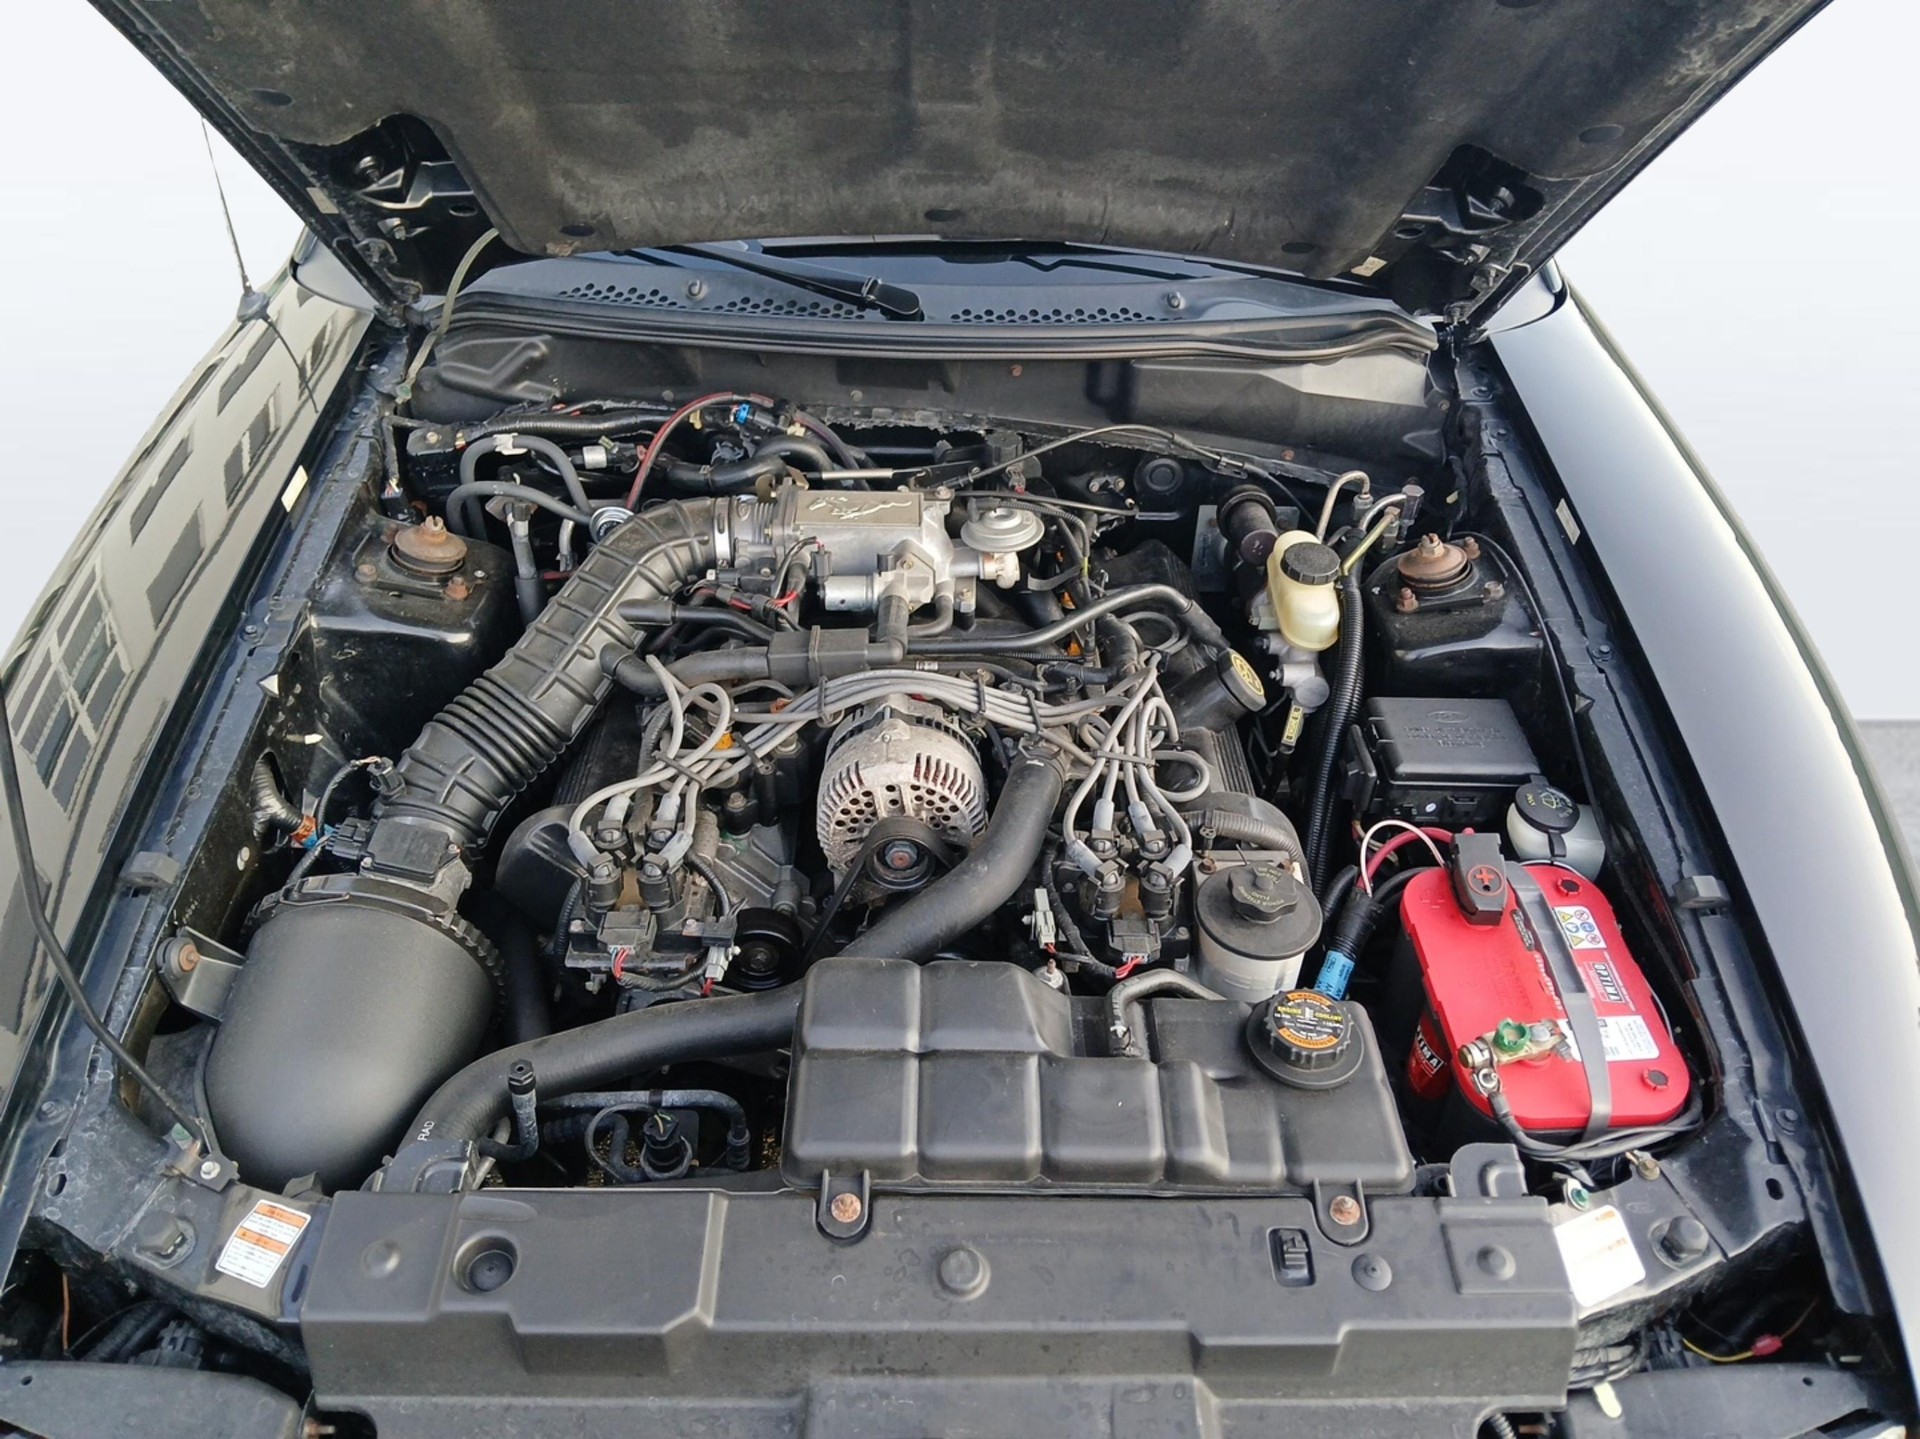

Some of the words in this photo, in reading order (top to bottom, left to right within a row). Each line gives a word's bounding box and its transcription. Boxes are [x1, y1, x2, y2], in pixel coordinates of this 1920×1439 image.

[1594, 963, 1621, 1001] OPTIMA
[1277, 1005, 1302, 1015] ENGINE
[1315, 1011, 1343, 1022] COOLANT
[417, 1120, 435, 1141] RAD
